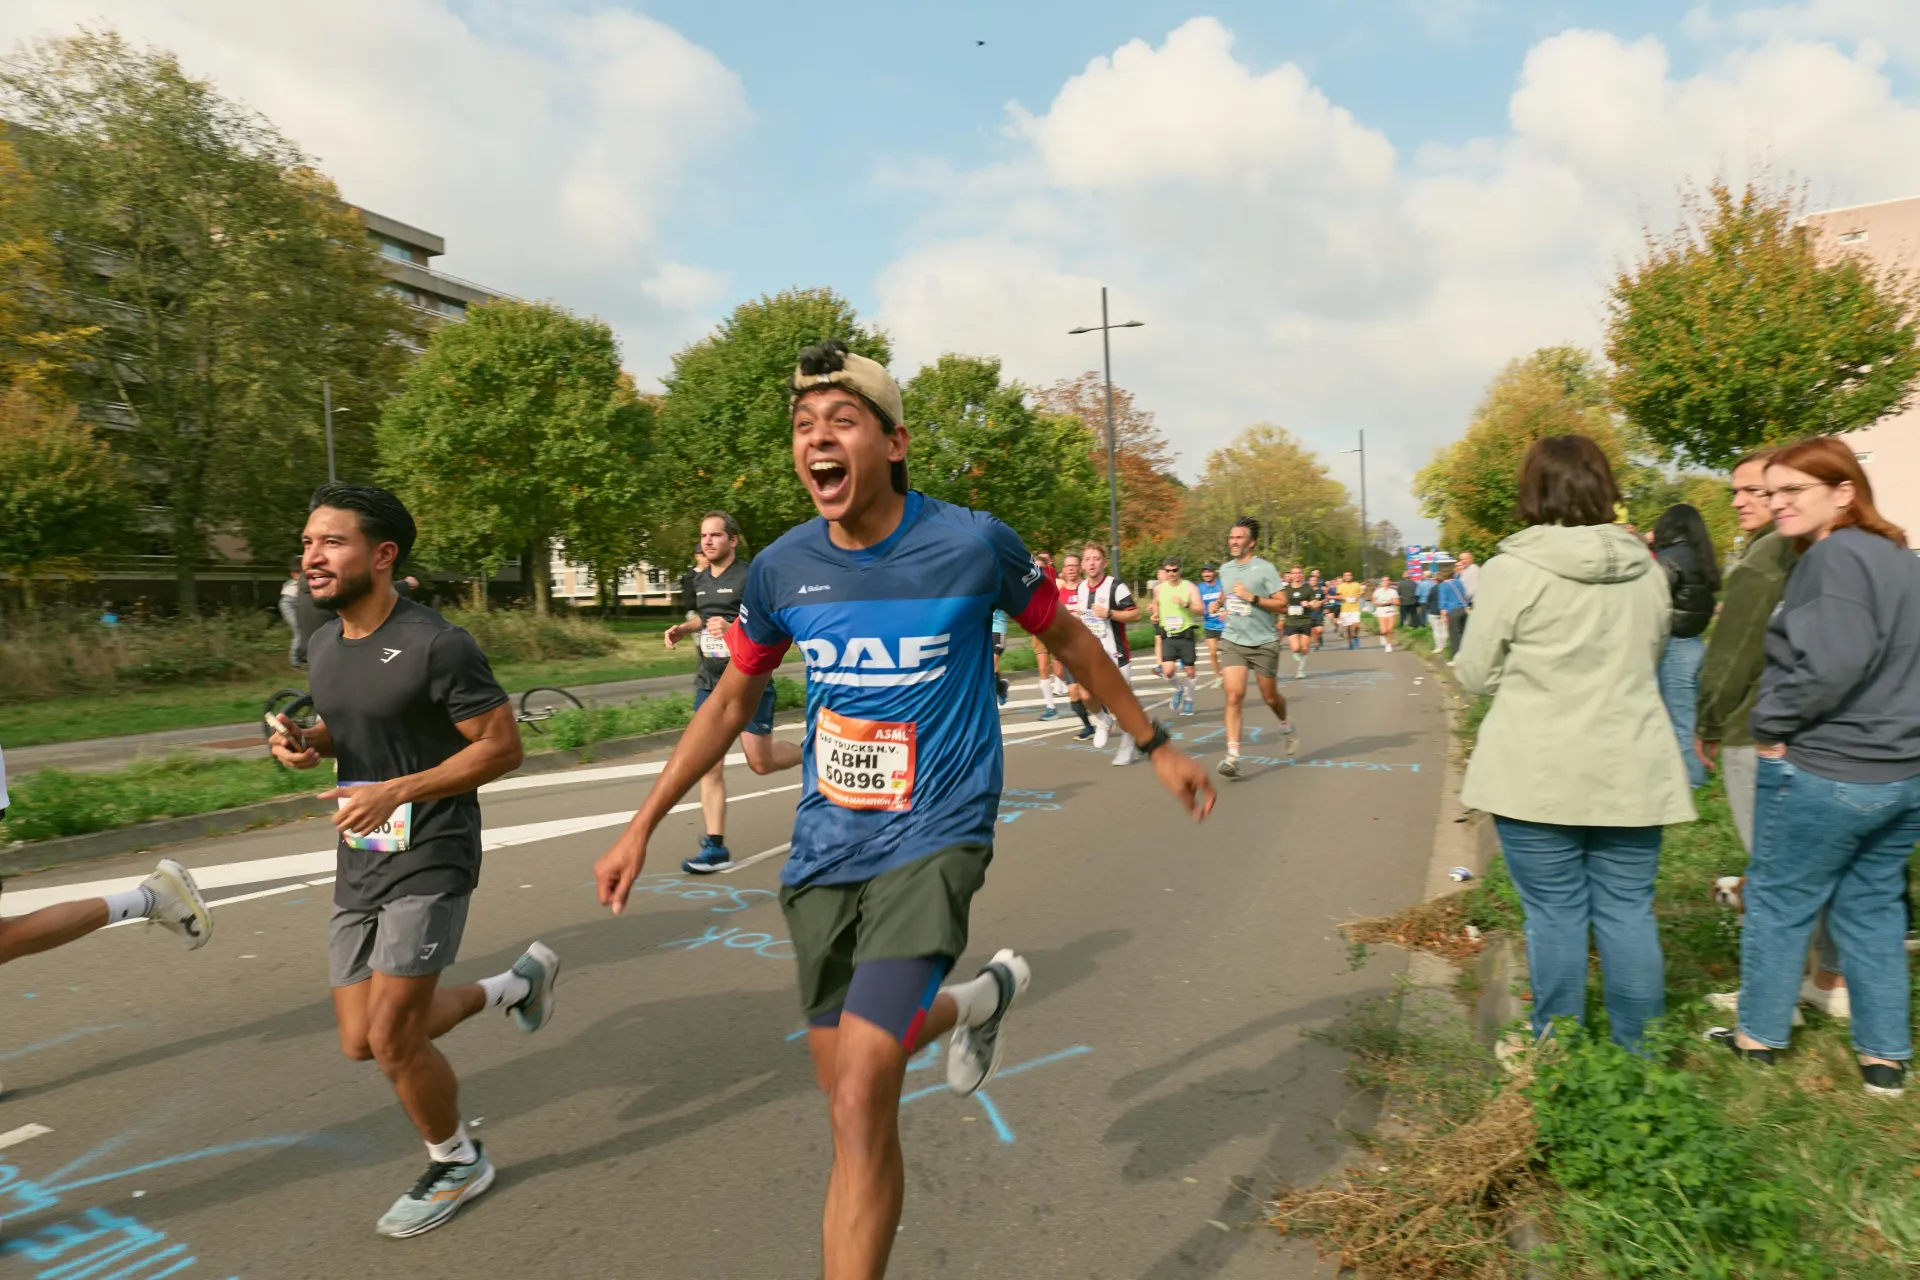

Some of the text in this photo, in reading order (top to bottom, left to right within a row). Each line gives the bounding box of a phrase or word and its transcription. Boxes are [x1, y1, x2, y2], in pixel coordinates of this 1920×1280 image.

[796, 633, 951, 669] DAF
[875, 728, 909, 741] ASML
[834, 739, 874, 753] TRUCKS
[830, 748, 878, 770] ABHI
[825, 764, 885, 790] 50896
